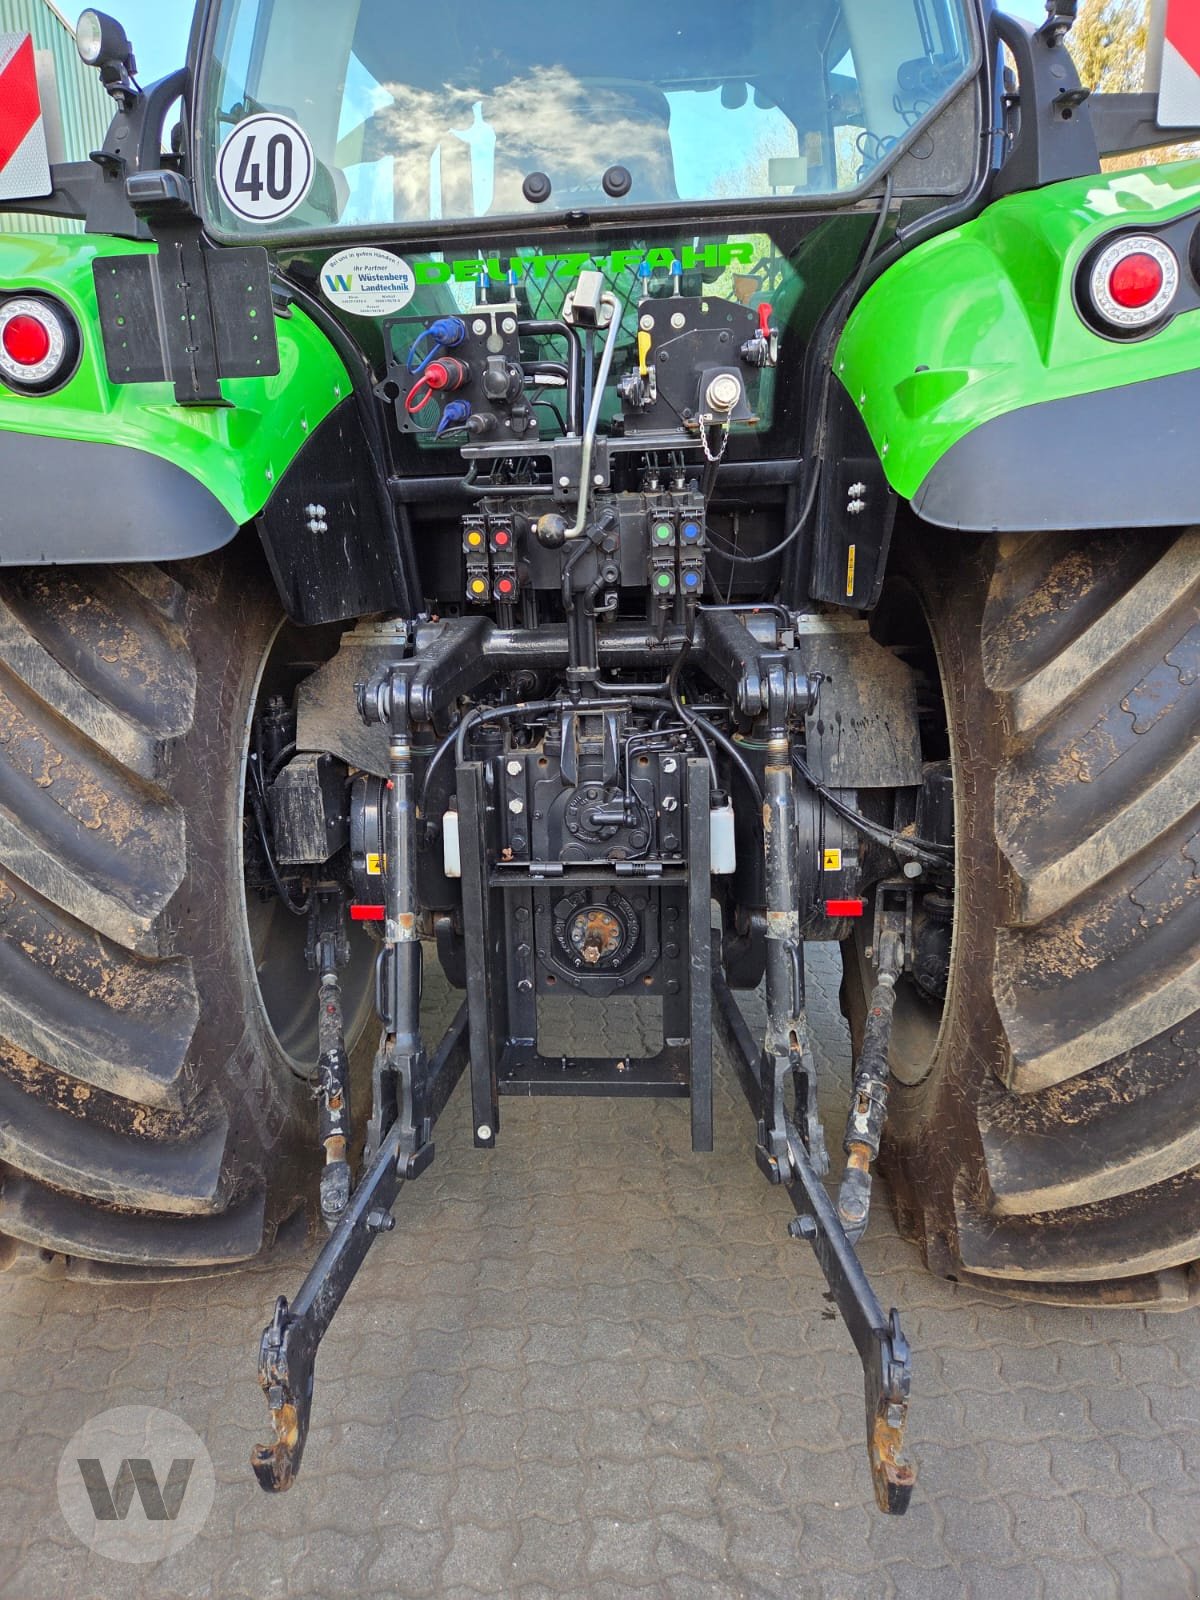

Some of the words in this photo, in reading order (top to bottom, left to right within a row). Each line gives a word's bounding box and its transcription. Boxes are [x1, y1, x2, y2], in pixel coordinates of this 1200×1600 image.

[235, 133, 293, 201] 40
[414, 242, 754, 285] DEUTZ-FAHR
[358, 273, 409, 282] Wüstenberg
[361, 283, 409, 292] Landtechnik
